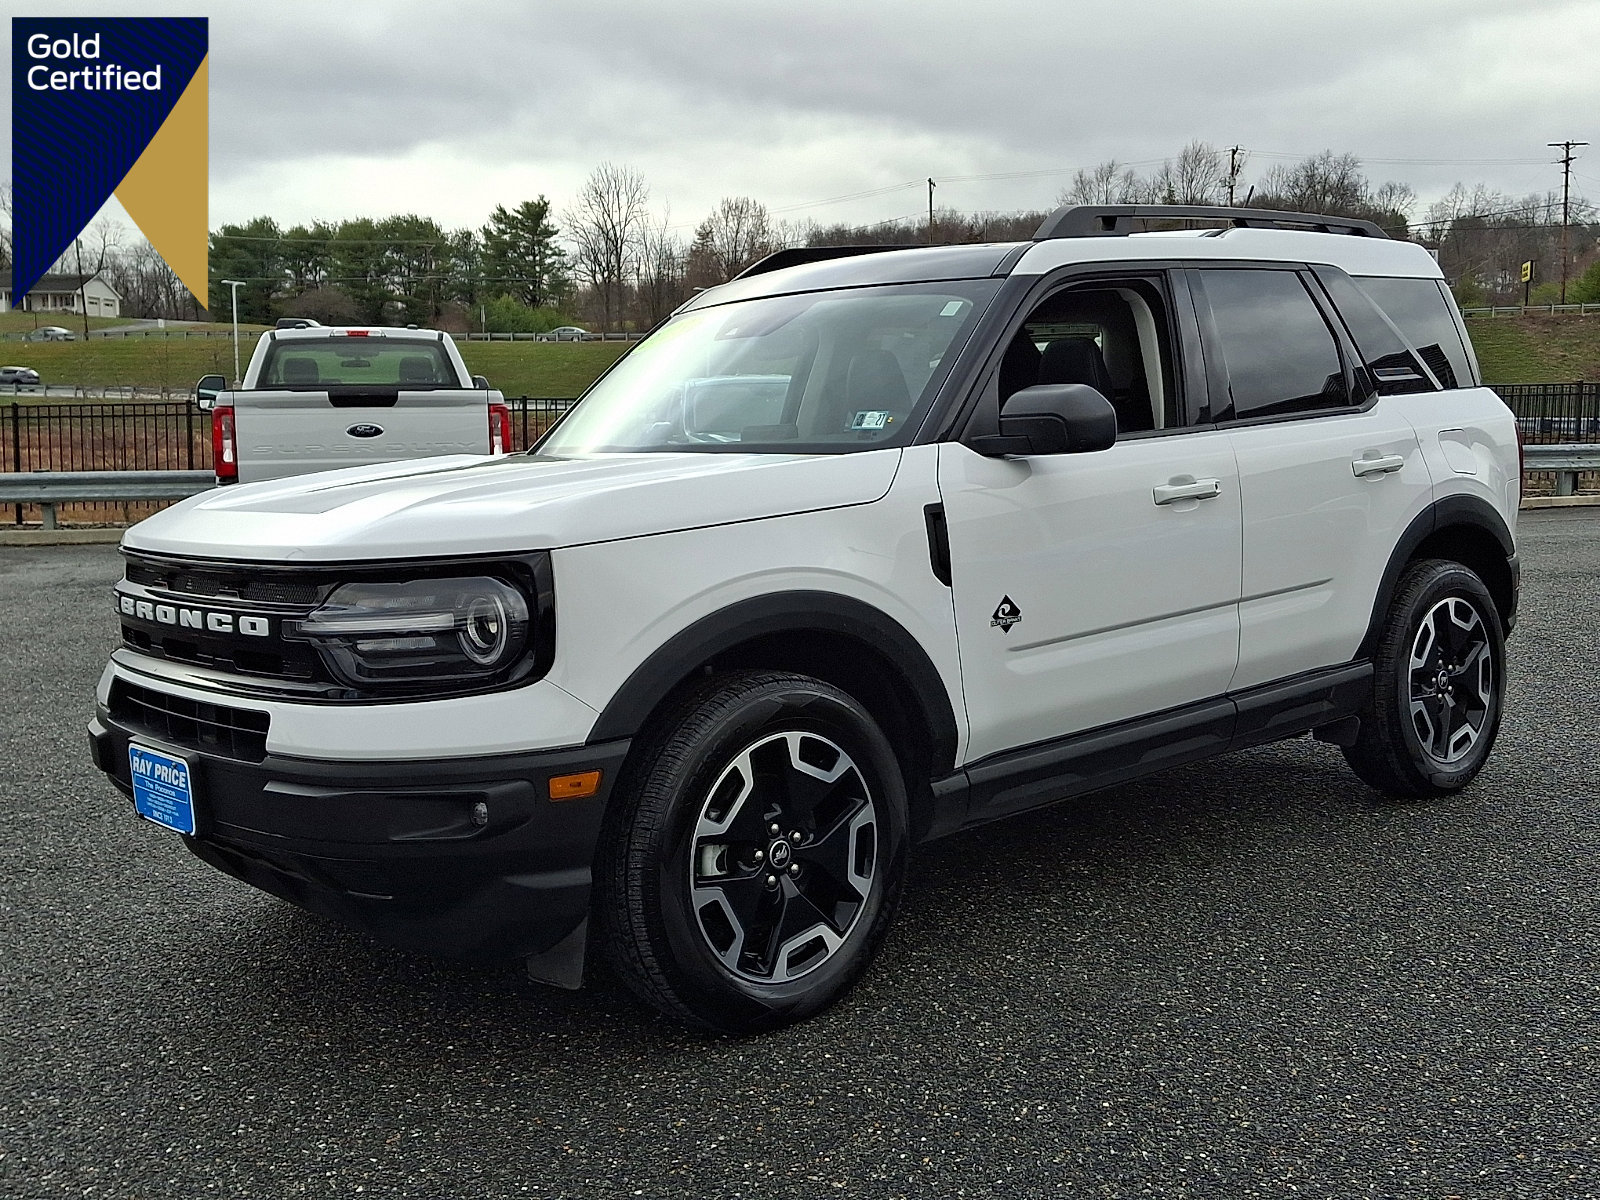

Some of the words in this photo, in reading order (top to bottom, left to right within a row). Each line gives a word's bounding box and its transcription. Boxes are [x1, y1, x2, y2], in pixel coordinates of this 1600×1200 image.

[252, 444, 375, 455] SUPER
[386, 442, 476, 453] DUTY
[120, 596, 270, 637] BRONCO
[133, 755, 153, 777] RAY
[154, 763, 187, 788] PRICE
[144, 780, 154, 789] The
